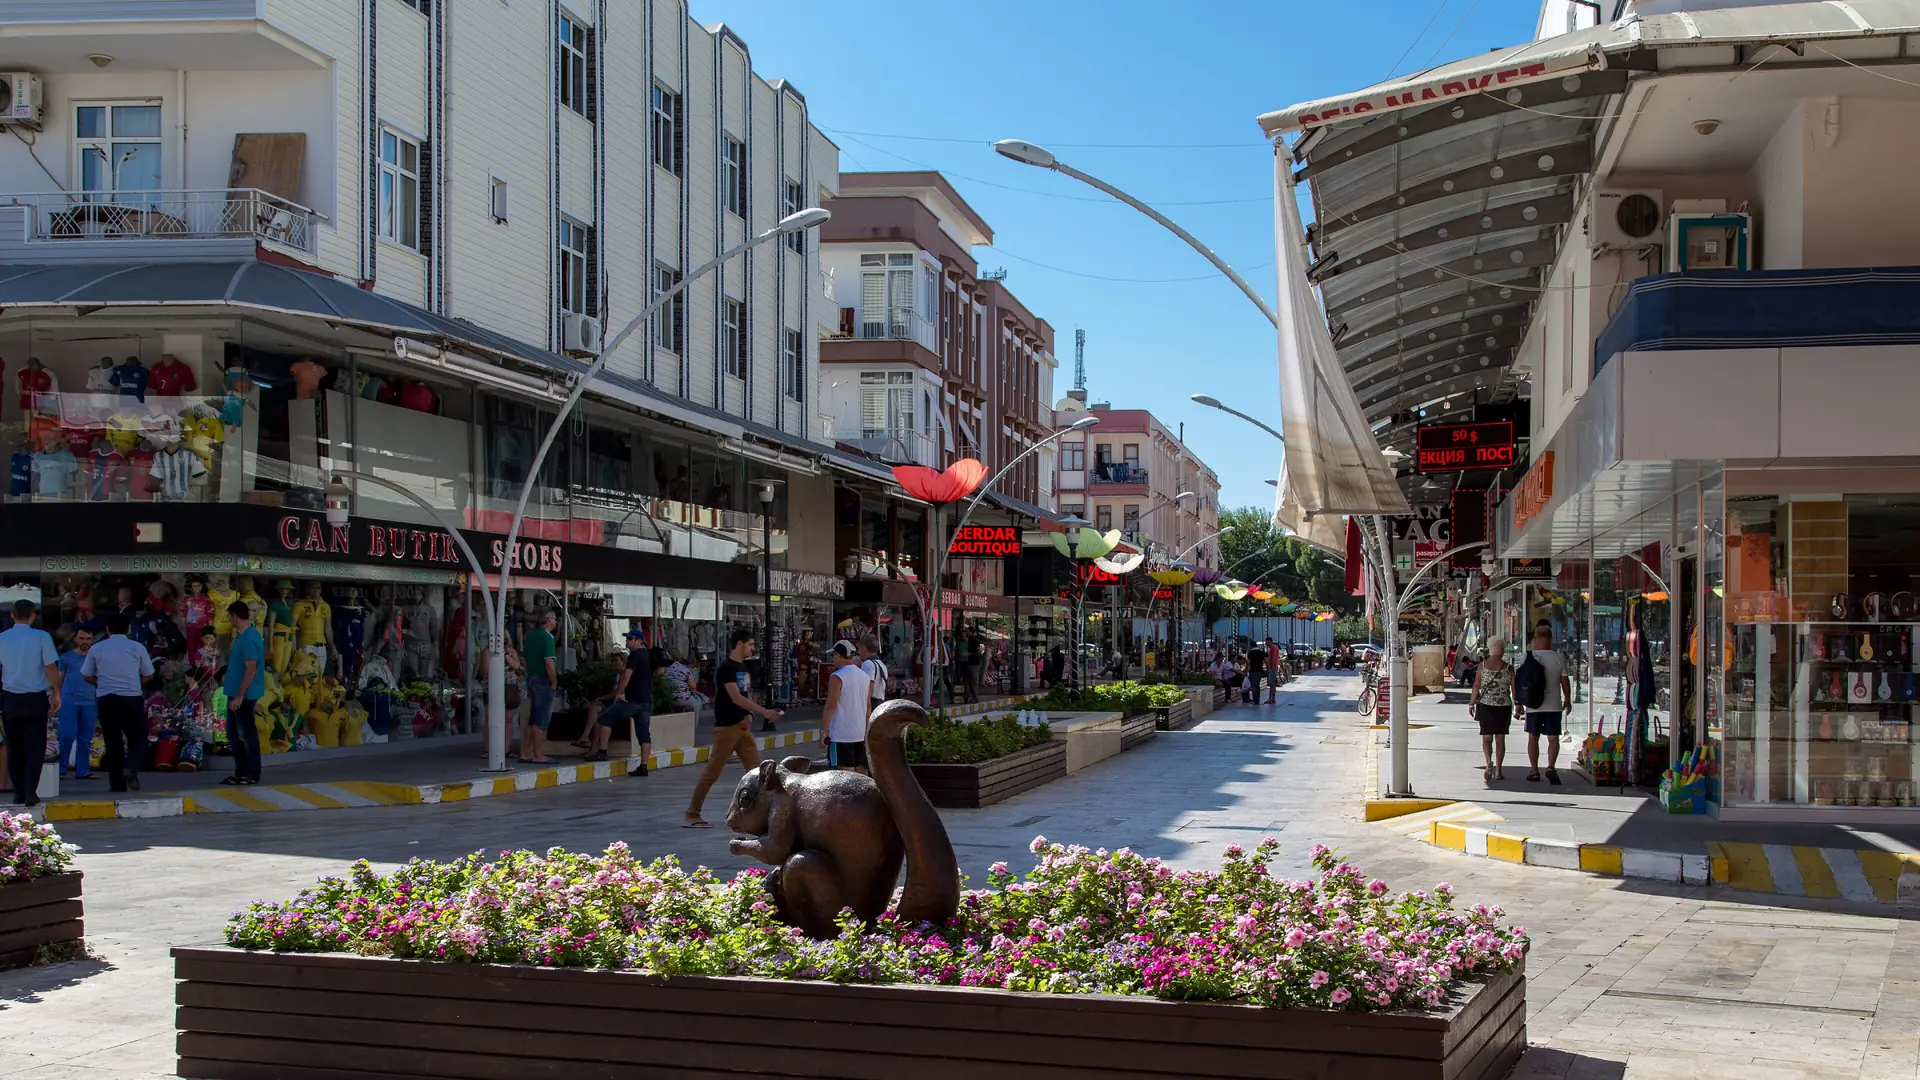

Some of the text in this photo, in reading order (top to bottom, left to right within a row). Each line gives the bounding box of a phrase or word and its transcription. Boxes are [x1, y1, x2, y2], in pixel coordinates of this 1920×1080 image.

[1452, 429, 1478, 444] 50 $
[1420, 449, 1465, 466] ЕКЦИЯ
[953, 527, 1016, 541] SERDAR
[280, 516, 562, 572] CAN BUTIK SHOES
[949, 541, 1021, 556] BOUTIQUE
[45, 556, 233, 570] GOLF & TENNIS SHOP
[942, 591, 987, 608] SERDAR BOUTIQUE
